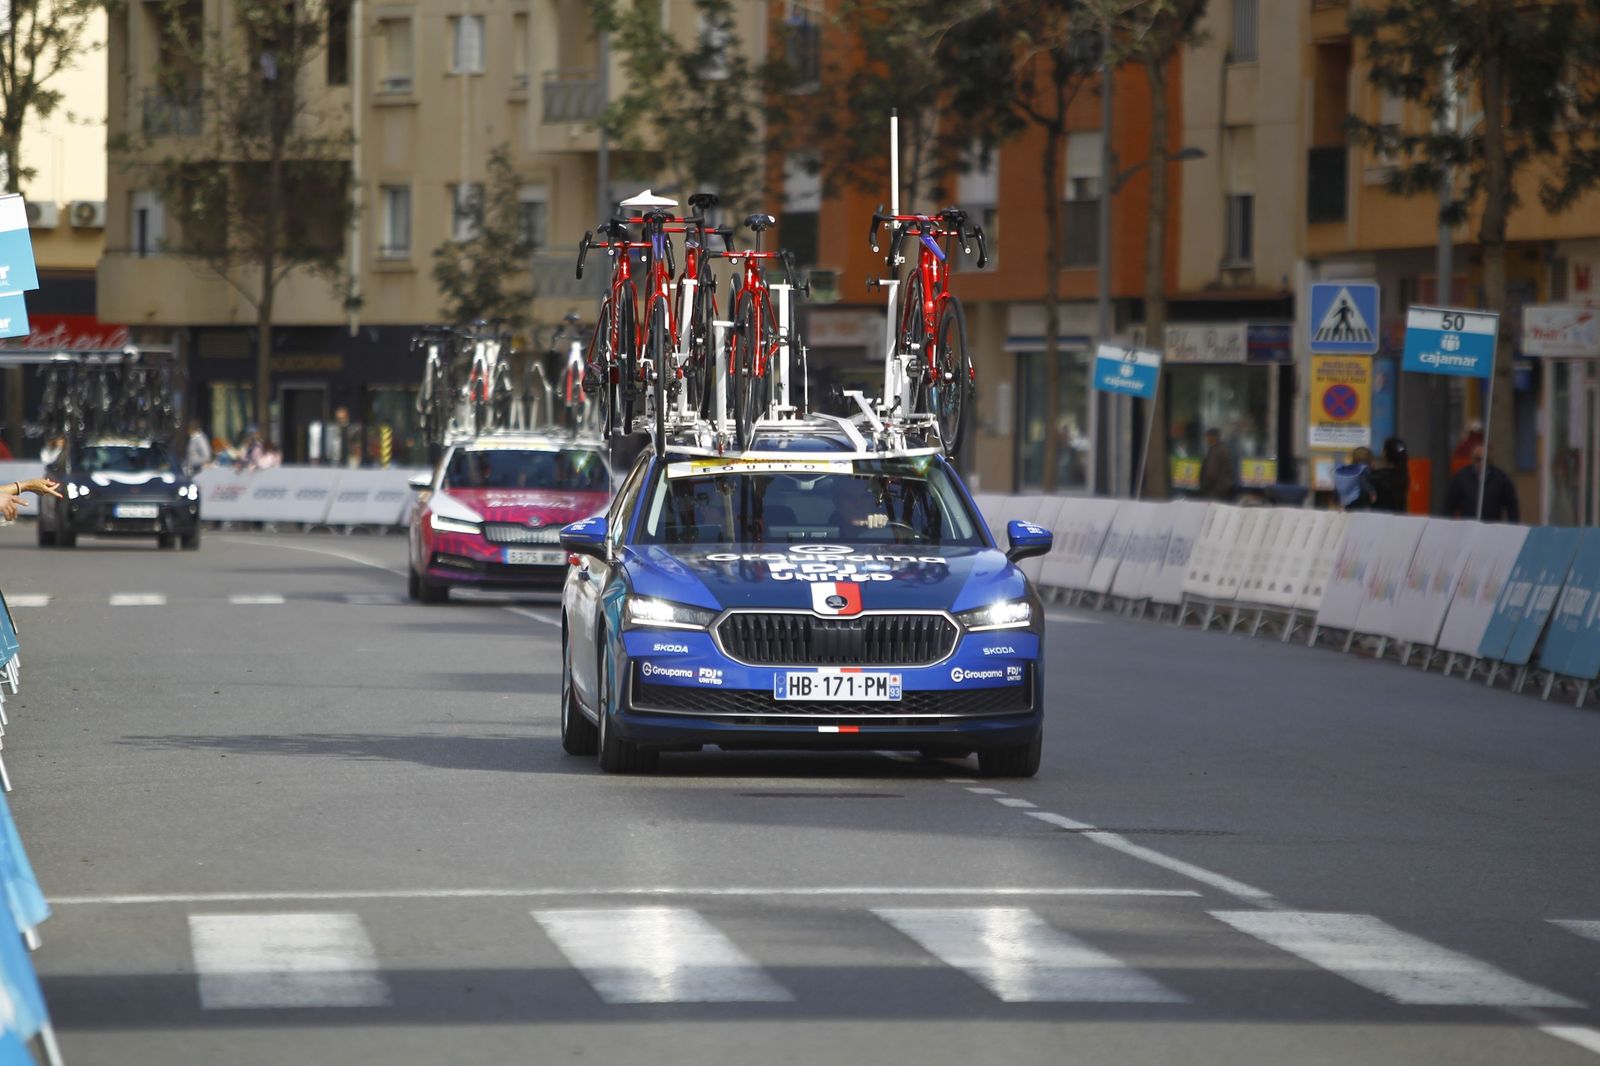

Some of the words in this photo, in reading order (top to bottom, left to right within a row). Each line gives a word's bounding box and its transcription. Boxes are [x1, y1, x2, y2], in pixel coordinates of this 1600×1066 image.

[1441, 311, 1465, 331] 50
[1419, 351, 1478, 368] cajamar
[706, 553, 946, 564] Groupama
[768, 561, 857, 574] FDJ
[771, 572, 893, 582] UNITED
[652, 665, 693, 678] Groupama
[699, 667, 717, 679] FDJ
[964, 669, 1003, 680] Groupama
[1006, 666, 1019, 676] FDJ
[698, 677, 723, 685] UNITED
[789, 676, 888, 697] HB-171-PM
[890, 687, 900, 697] 93
